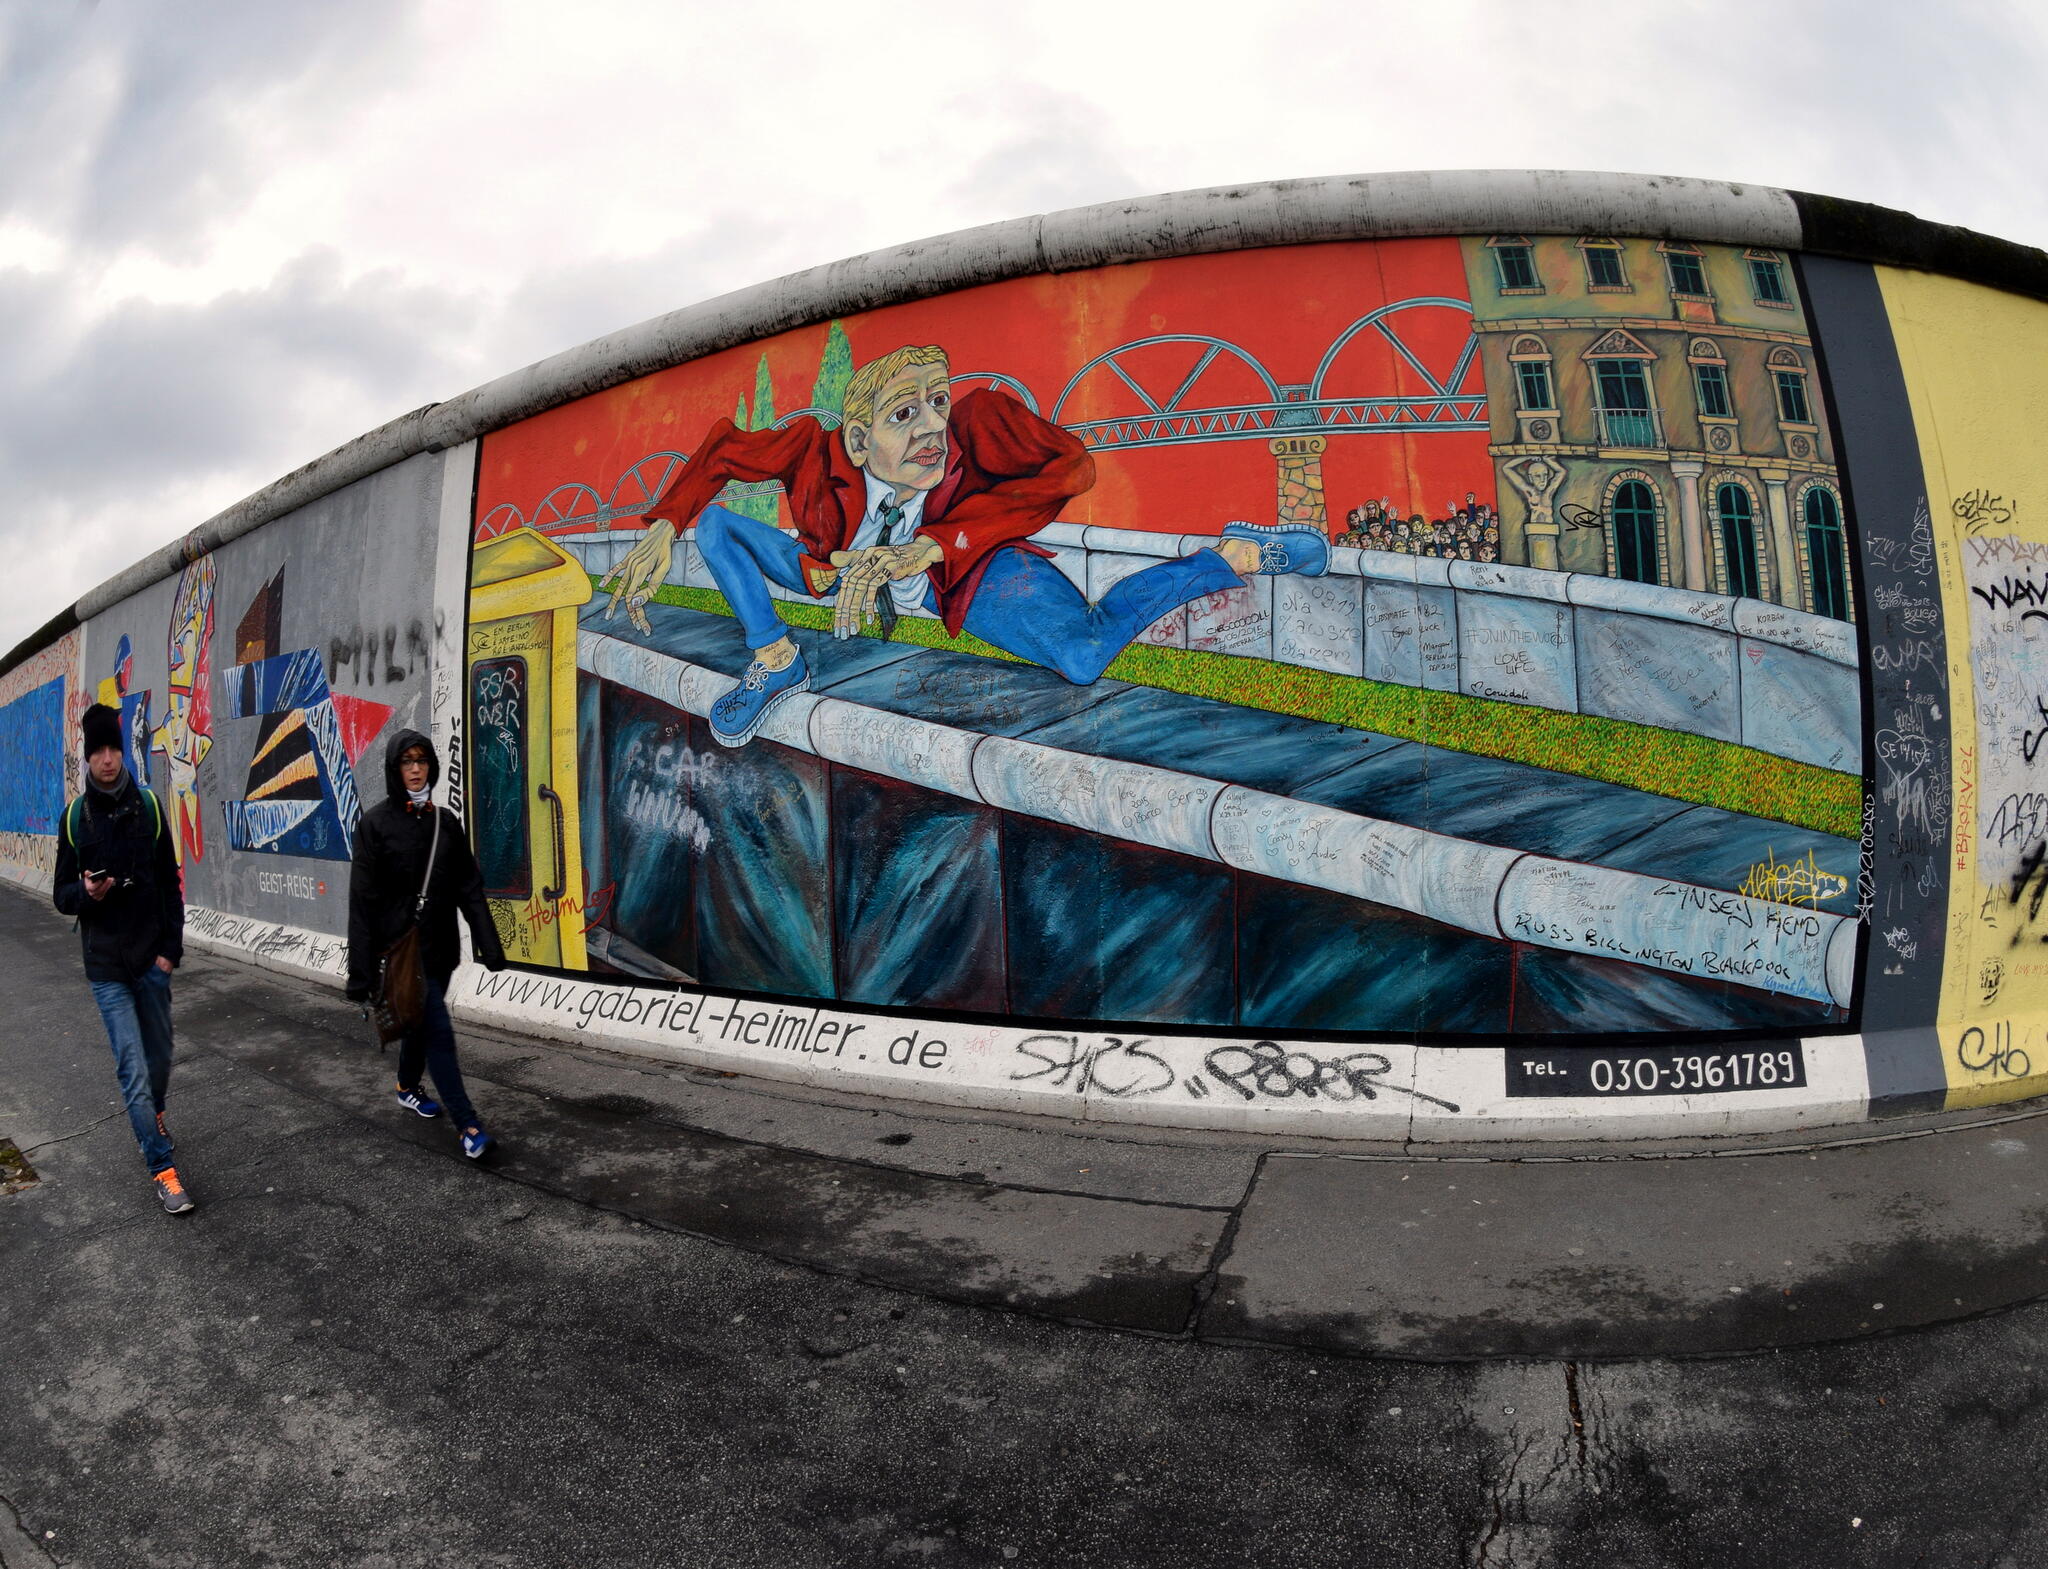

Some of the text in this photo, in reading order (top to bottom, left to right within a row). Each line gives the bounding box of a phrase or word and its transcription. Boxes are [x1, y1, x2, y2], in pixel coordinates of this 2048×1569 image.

[1494, 650, 1528, 666] LOVE
[259, 871, 315, 900] GEIST-REISE
[1590, 1051, 1795, 1092] 030-3961789
